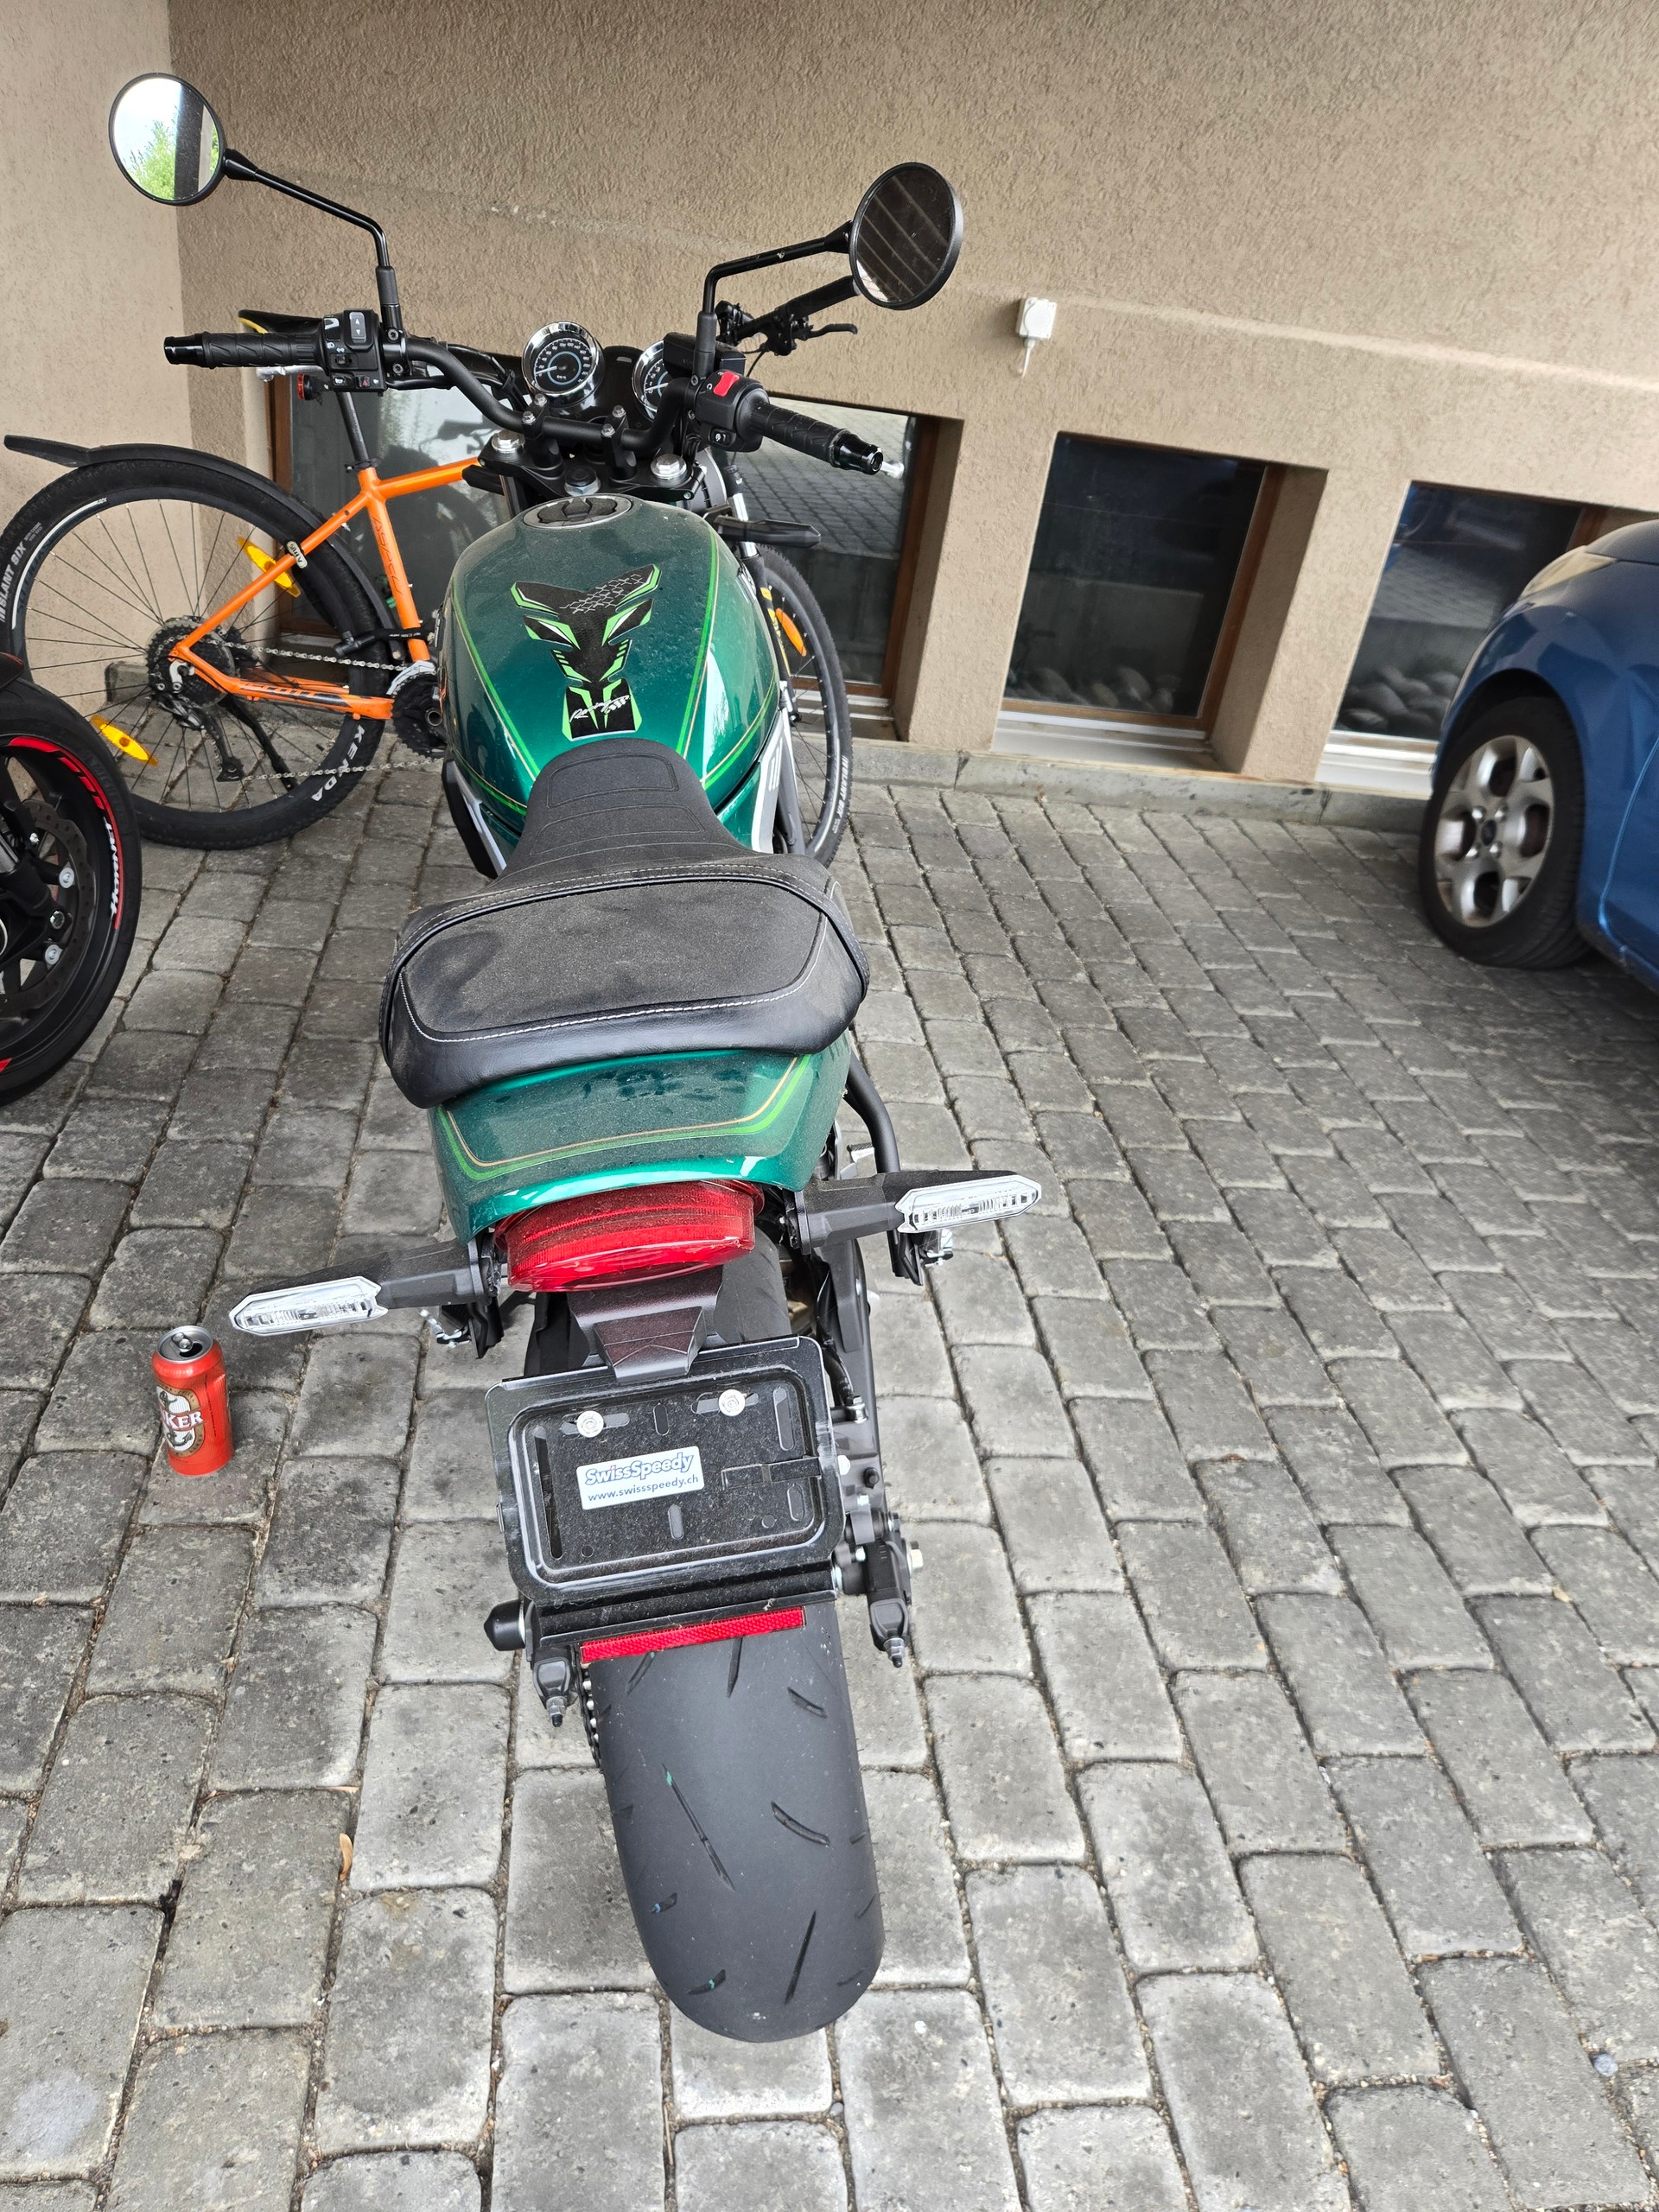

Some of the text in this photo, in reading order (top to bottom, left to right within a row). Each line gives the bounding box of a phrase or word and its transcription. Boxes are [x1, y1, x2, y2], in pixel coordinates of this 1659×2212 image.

[10, 541, 27, 565] SIX
[311, 724, 365, 802] KENDA
[585, 1452, 694, 1485] SwissSpeedy
[588, 1474, 699, 1502] www.swissspeedy.ch
